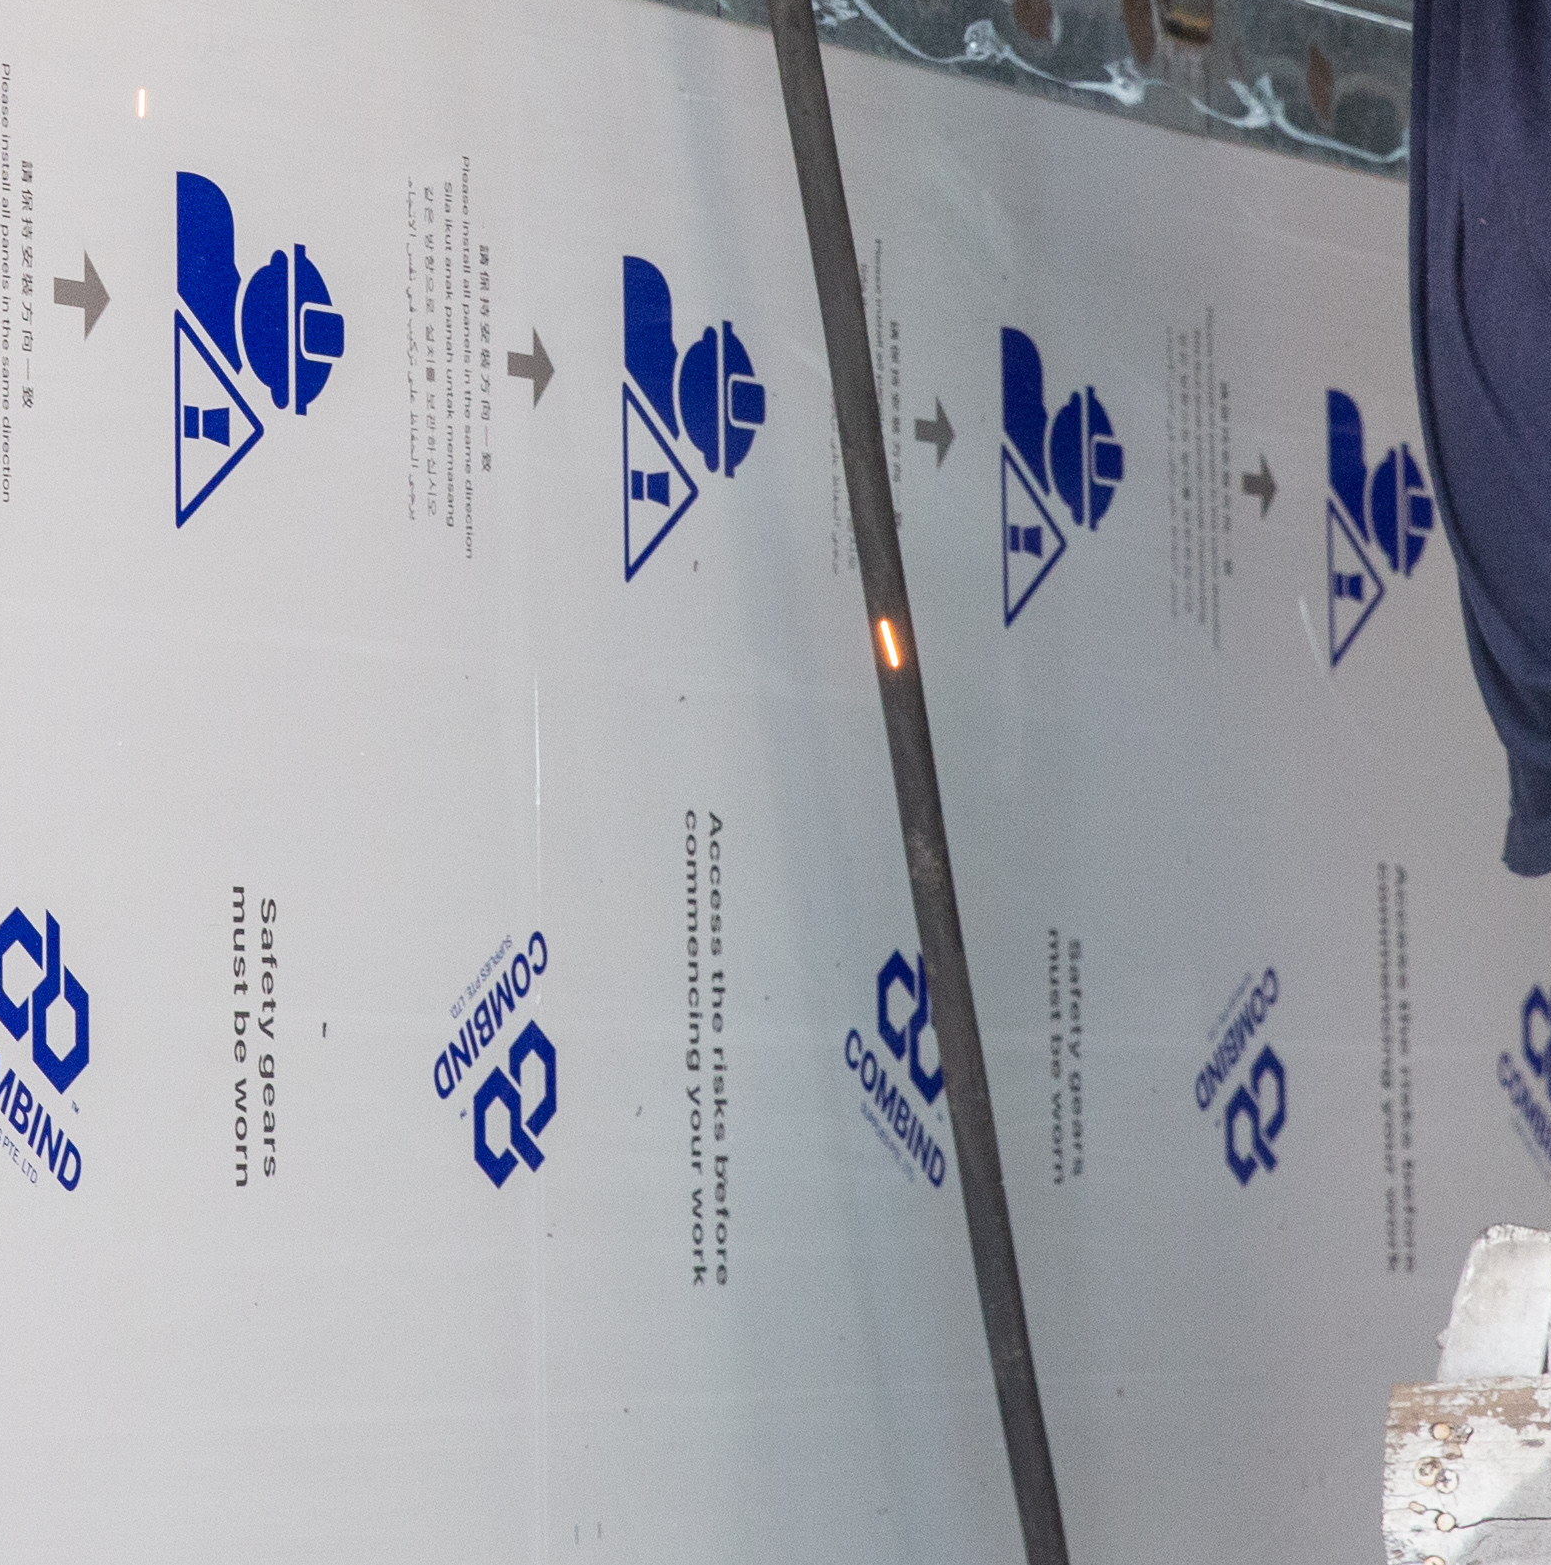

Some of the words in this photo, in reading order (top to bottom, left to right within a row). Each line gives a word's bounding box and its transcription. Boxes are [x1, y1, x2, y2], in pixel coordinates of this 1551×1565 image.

[1, 63, 11, 128] Please
[1, 134, 11, 192] install
[462, 156, 470, 216] Please
[2, 197, 11, 219] all
[462, 220, 471, 274] install
[0, 224, 11, 290] panels
[21, 160, 34, 409] 請保持安裝方向一致
[463, 278, 471, 299] all
[2, 296, 11, 313] in
[2, 319, 11, 351] the
[461, 303, 472, 363] panels
[464, 369, 472, 384] in
[464, 390, 472, 419] the
[2, 416, 12, 503] direction
[465, 479, 474, 559] direction
[708, 811, 724, 957] Access
[232, 885, 249, 996] must
[257, 897, 278, 1040] Safety
[684, 809, 704, 1072] commencing
[1047, 927, 1063, 1023] must
[233, 1010, 251, 1064] be
[433, 931, 548, 1100] COMBIND
[711, 969, 727, 1034] the
[712, 1047, 728, 1142] risks
[1050, 1033, 1064, 1081] be
[234, 1077, 249, 1188] worn
[258, 1053, 277, 1178] gears
[685, 1084, 703, 1175] your
[845, 1028, 943, 1186] COMBIND
[1050, 1090, 1066, 1186] worn
[691, 1187, 708, 1287] work
[714, 1155, 731, 1286] before
